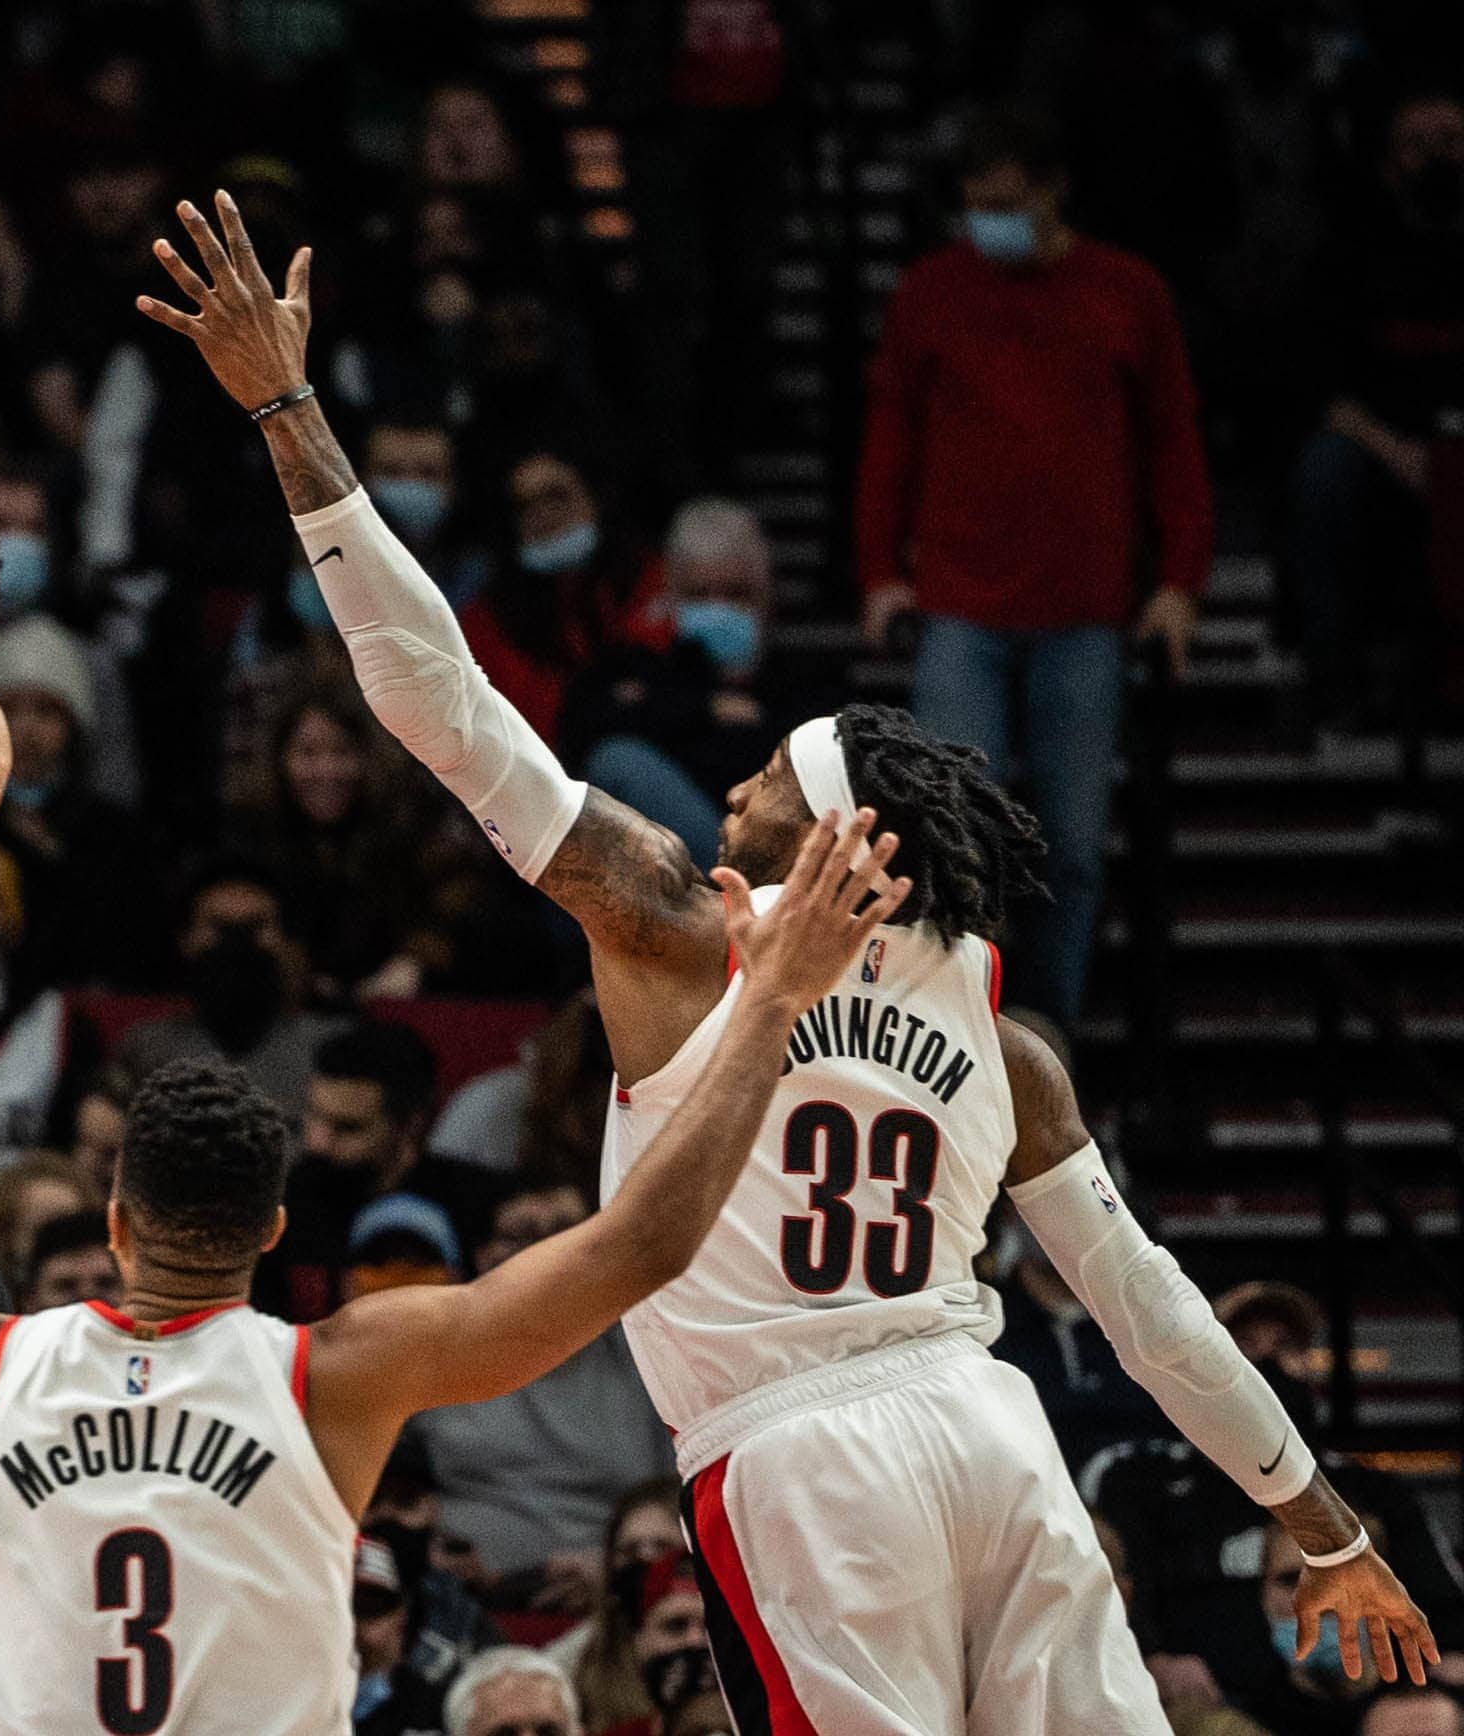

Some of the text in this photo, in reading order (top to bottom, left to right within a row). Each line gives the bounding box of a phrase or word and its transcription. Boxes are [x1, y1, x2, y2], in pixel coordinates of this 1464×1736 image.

[779, 995, 975, 1106] OVINGTON
[780, 1100, 940, 1299] 33
[94, 1526, 174, 1736] 3
